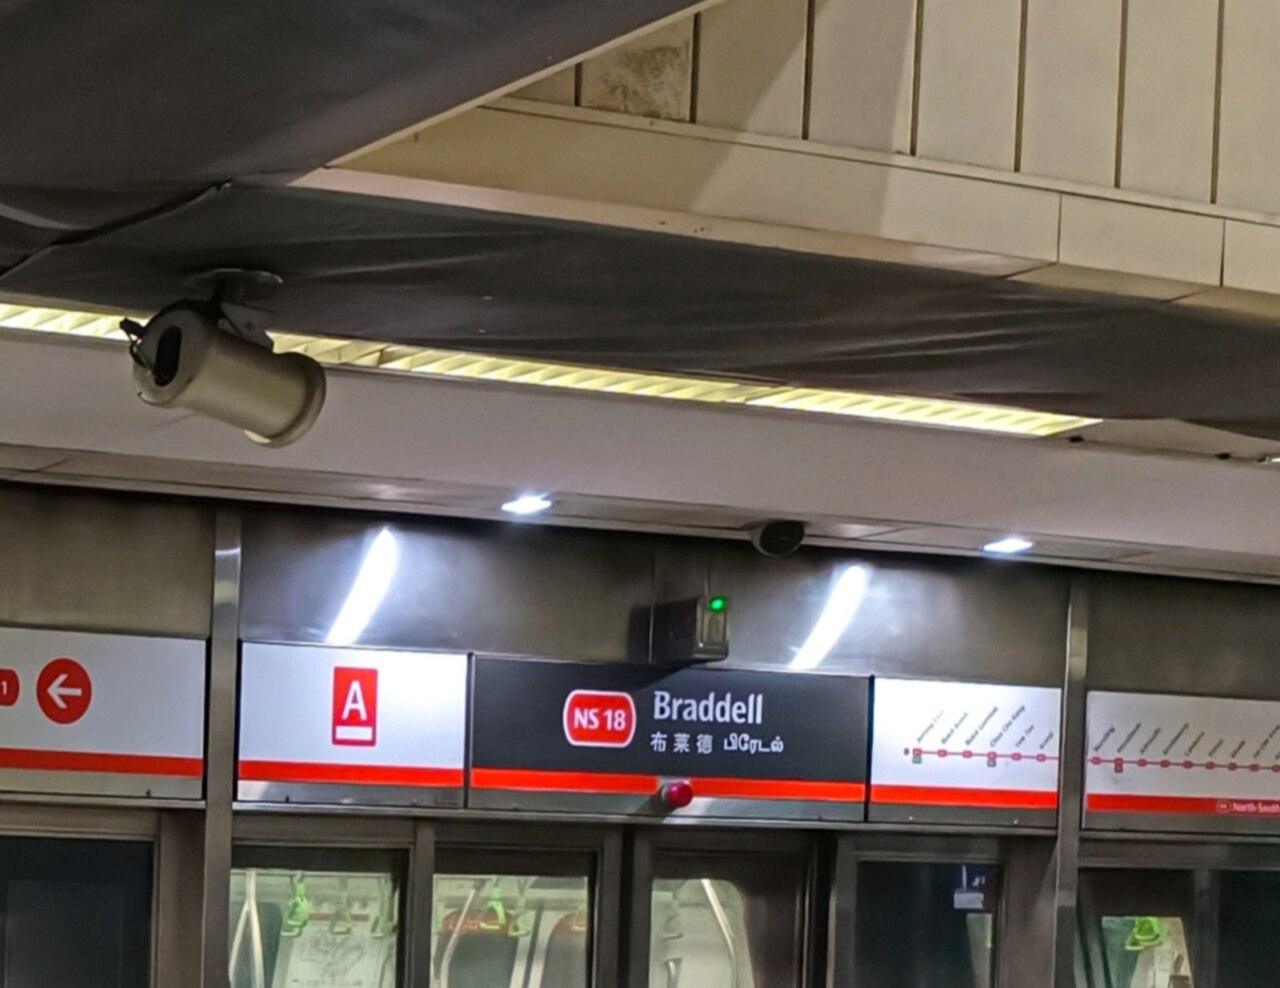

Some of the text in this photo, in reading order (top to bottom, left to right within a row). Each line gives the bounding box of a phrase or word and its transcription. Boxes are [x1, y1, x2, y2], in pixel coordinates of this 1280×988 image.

[1, 681, 8, 695] 1
[342, 680, 368, 720] A
[653, 690, 763, 725] Braddell
[574, 708, 626, 731] NS 18
[650, 731, 713, 754] 布莱德
